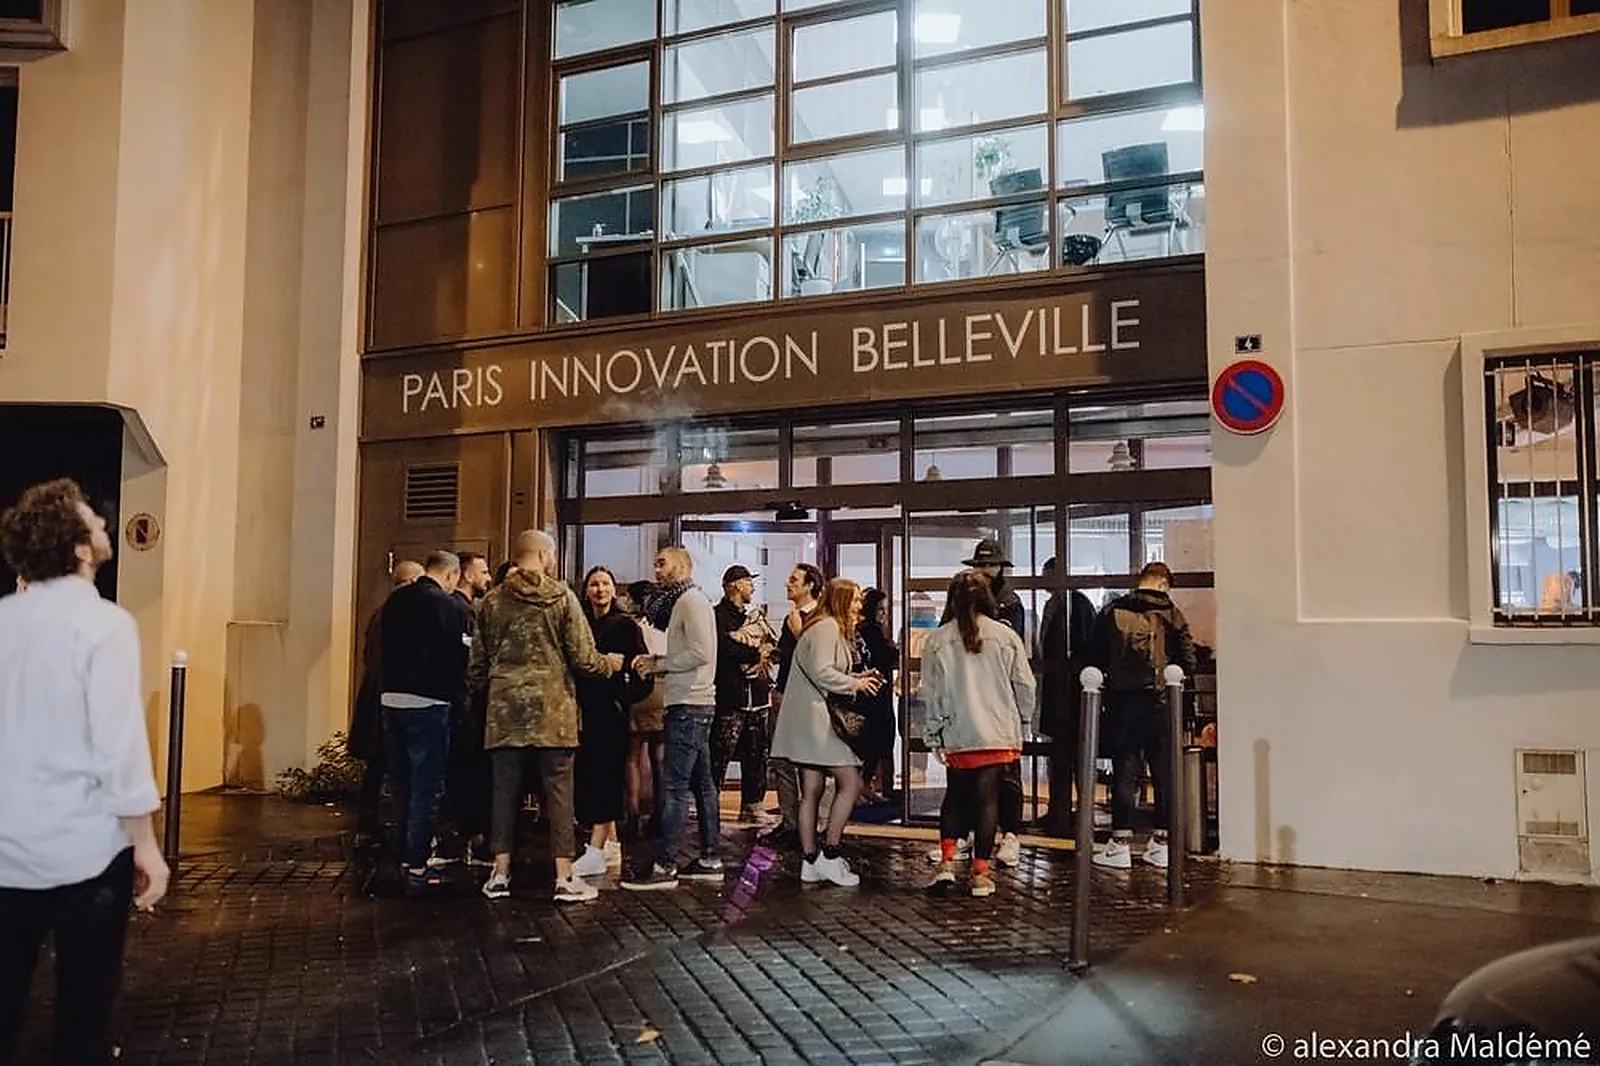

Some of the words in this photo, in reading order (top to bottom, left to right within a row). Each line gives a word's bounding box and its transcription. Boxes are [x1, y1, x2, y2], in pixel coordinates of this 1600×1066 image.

[402, 365, 503, 413] PARIS
[530, 331, 818, 401] INNOVATION
[852, 300, 1140, 373] BELLEVILLE
